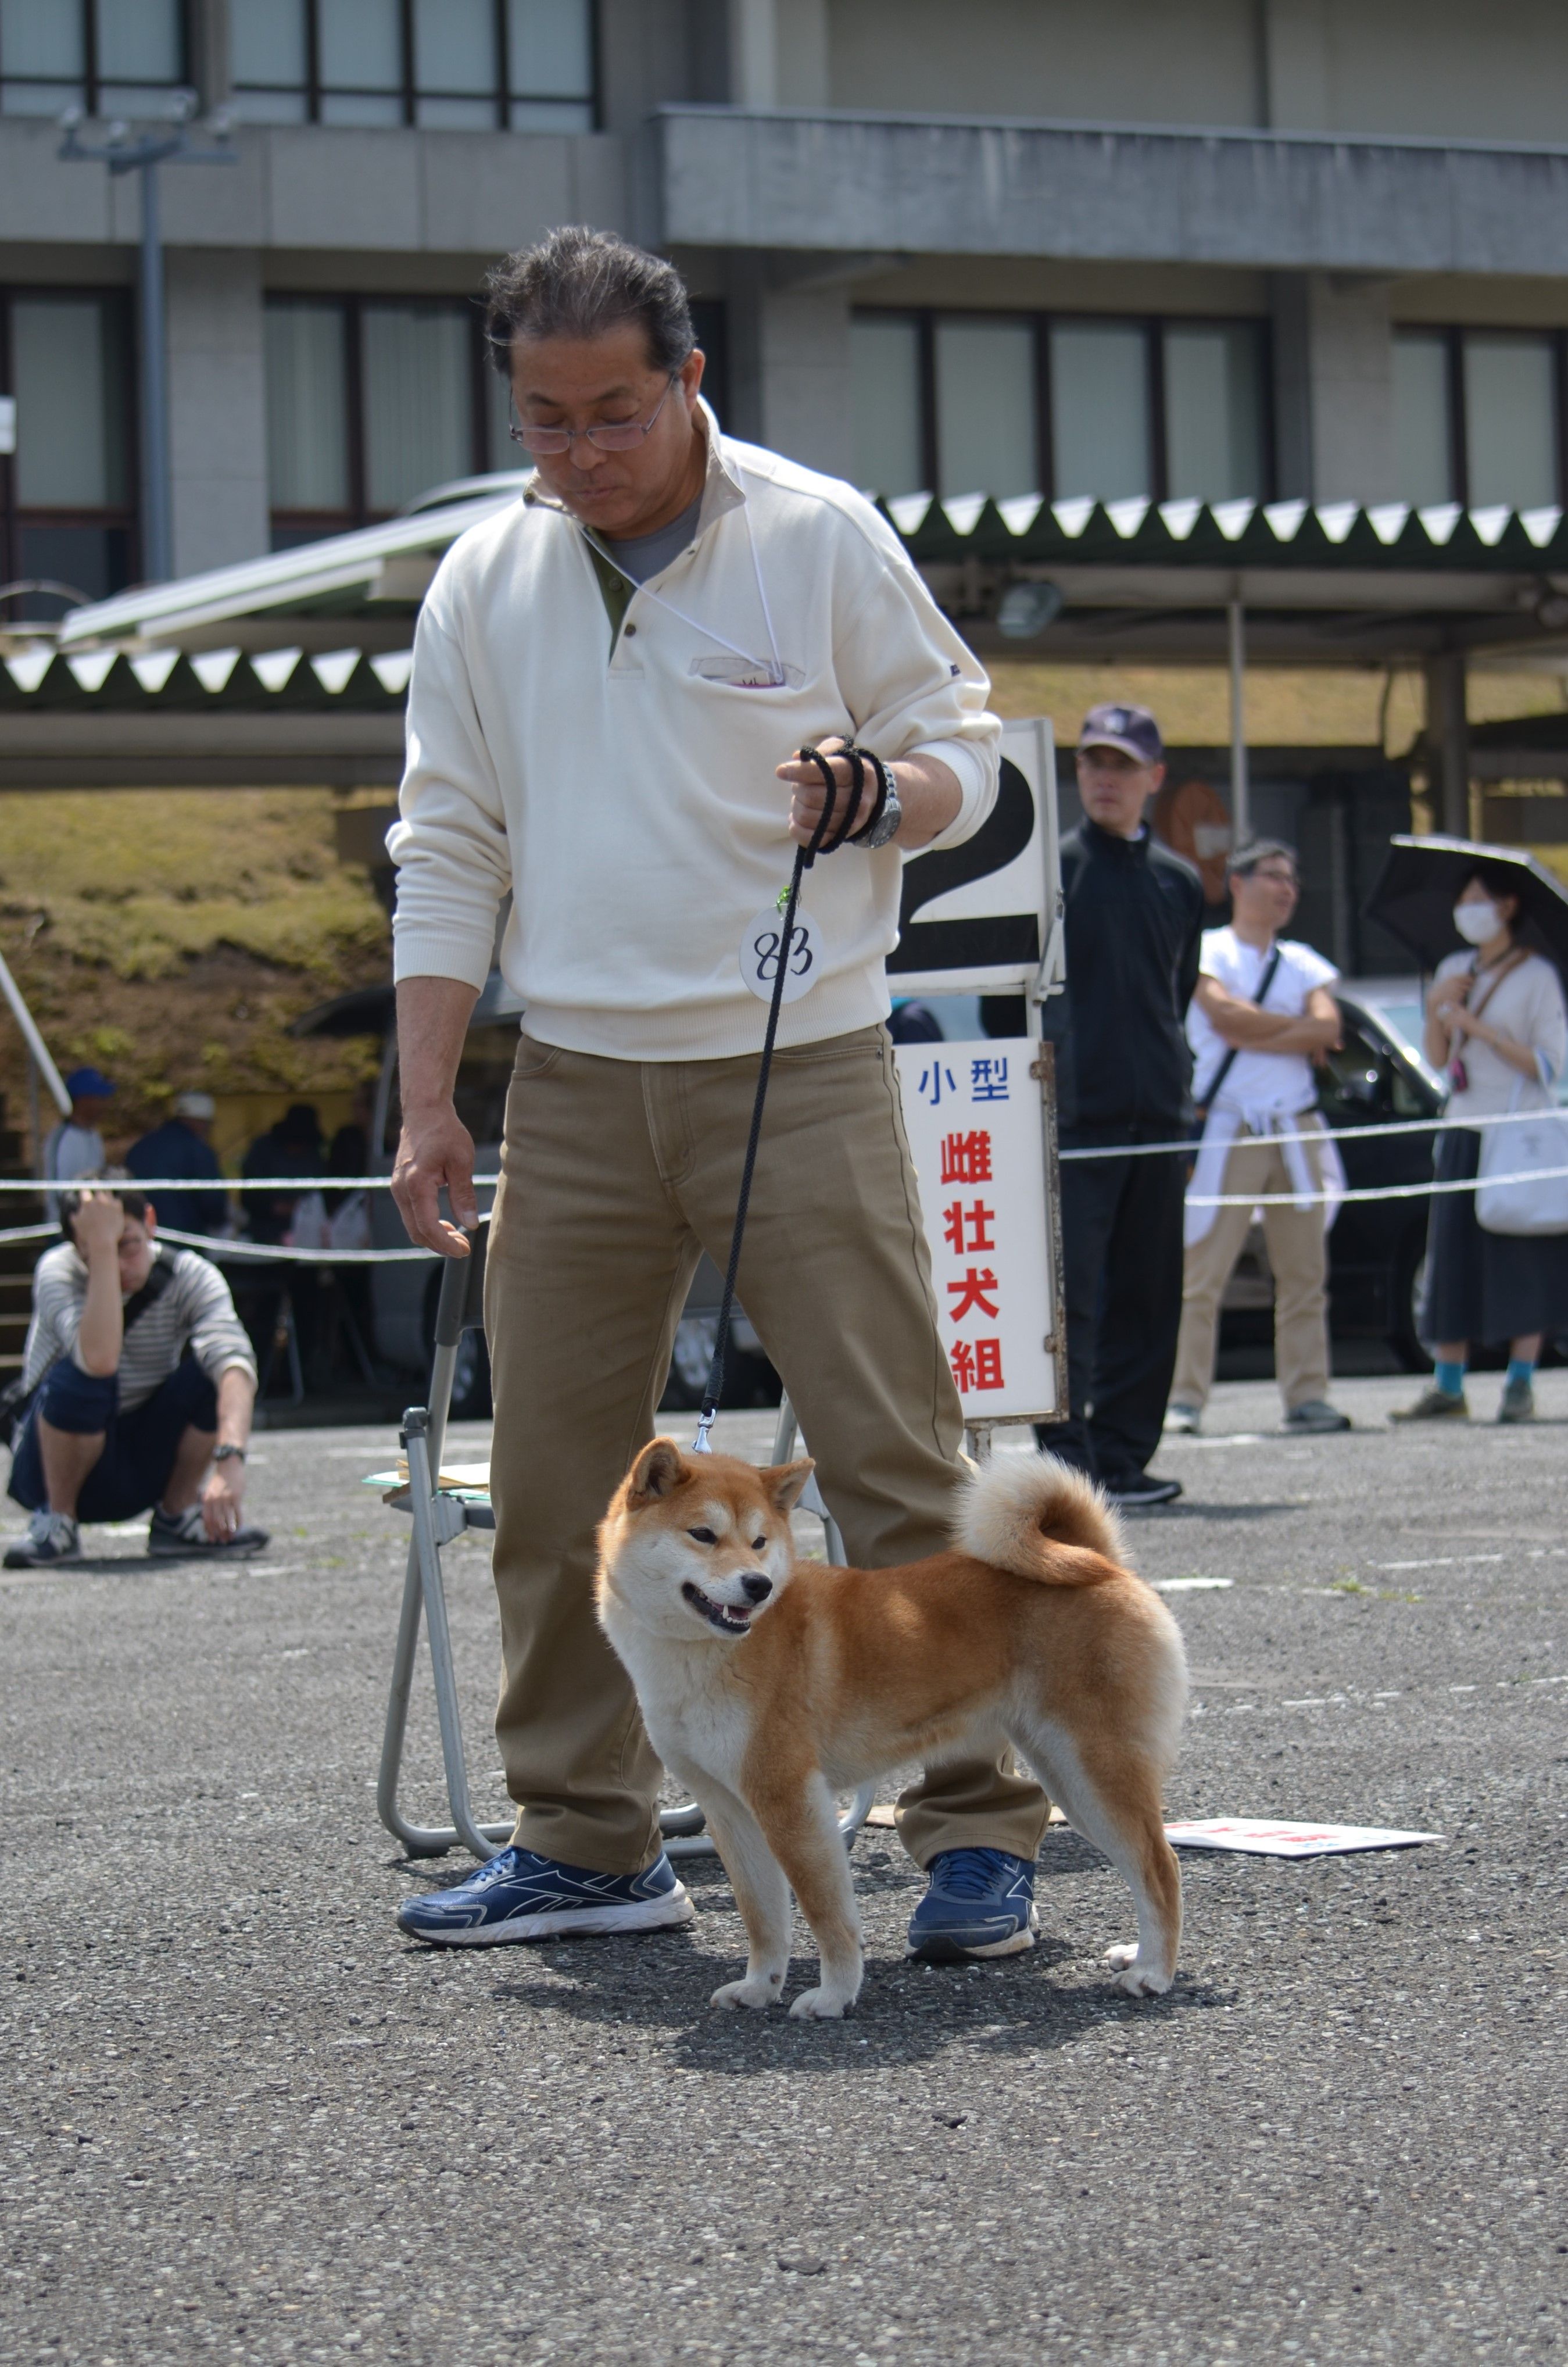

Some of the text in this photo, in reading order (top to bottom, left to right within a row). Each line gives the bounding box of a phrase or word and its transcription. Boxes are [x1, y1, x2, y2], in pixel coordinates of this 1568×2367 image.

[754, 927, 813, 981] 83
[918, 1057, 1009, 1106] 小型
[940, 1130, 1004, 1393] 雌壮犬組
